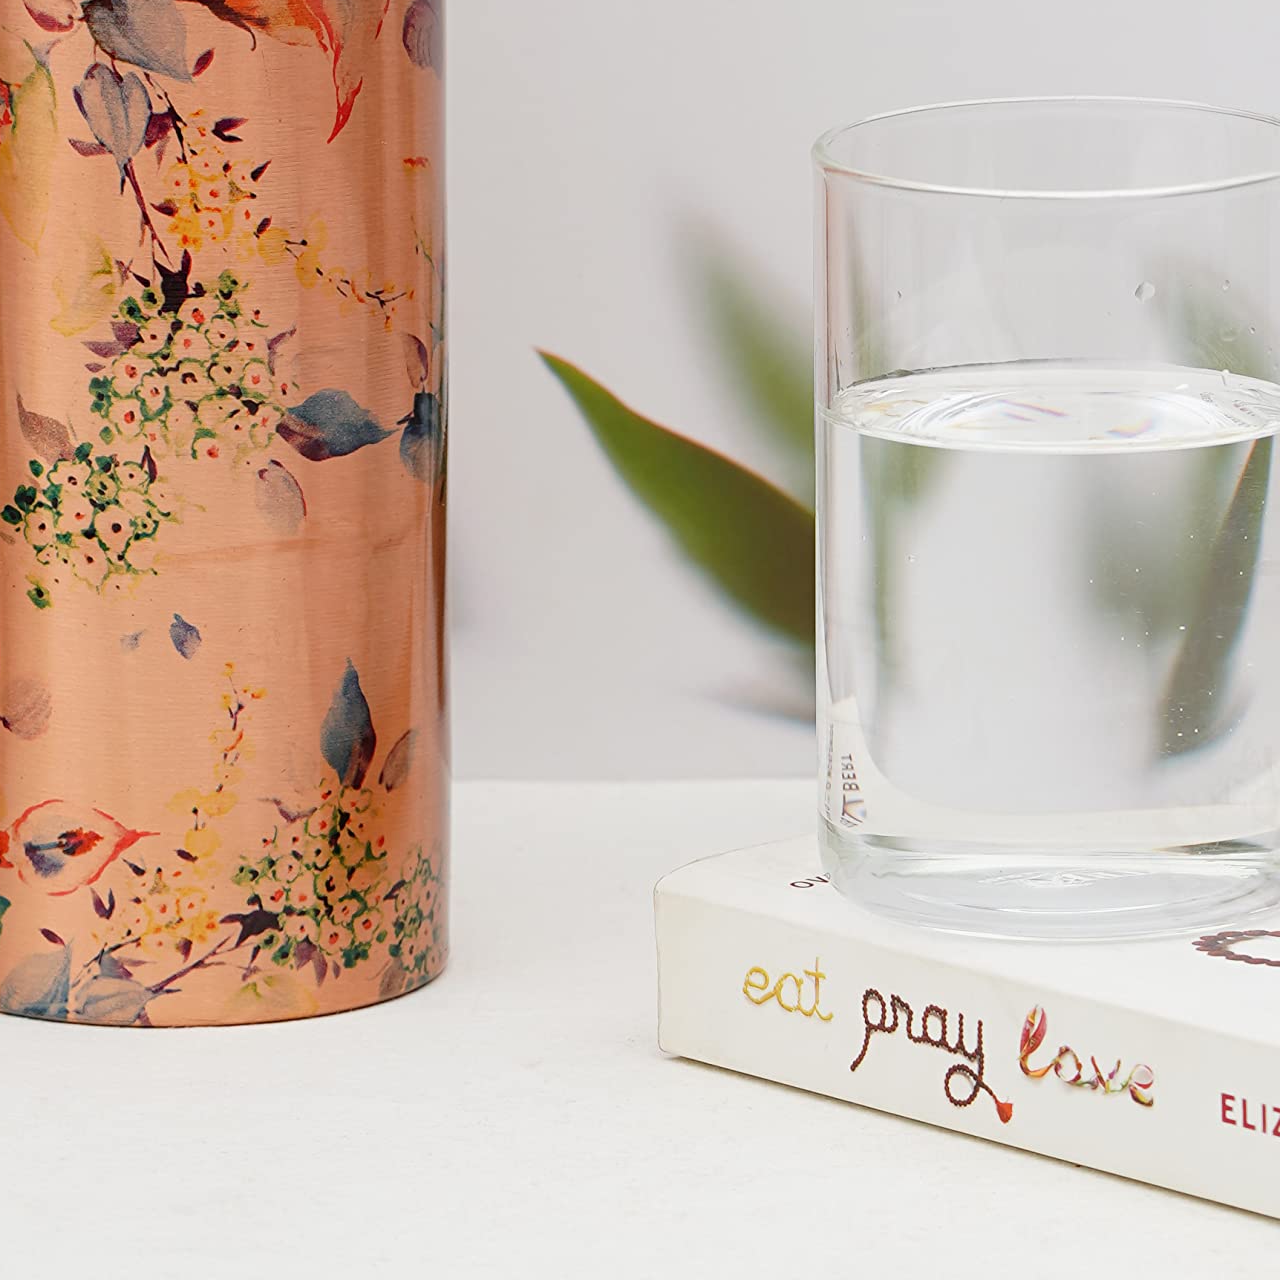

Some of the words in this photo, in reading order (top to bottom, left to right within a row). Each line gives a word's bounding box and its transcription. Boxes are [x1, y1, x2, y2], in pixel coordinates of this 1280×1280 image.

[743, 956, 833, 1021] eat
[850, 988, 1010, 1120] pray
[1018, 1004, 1154, 1107] love
